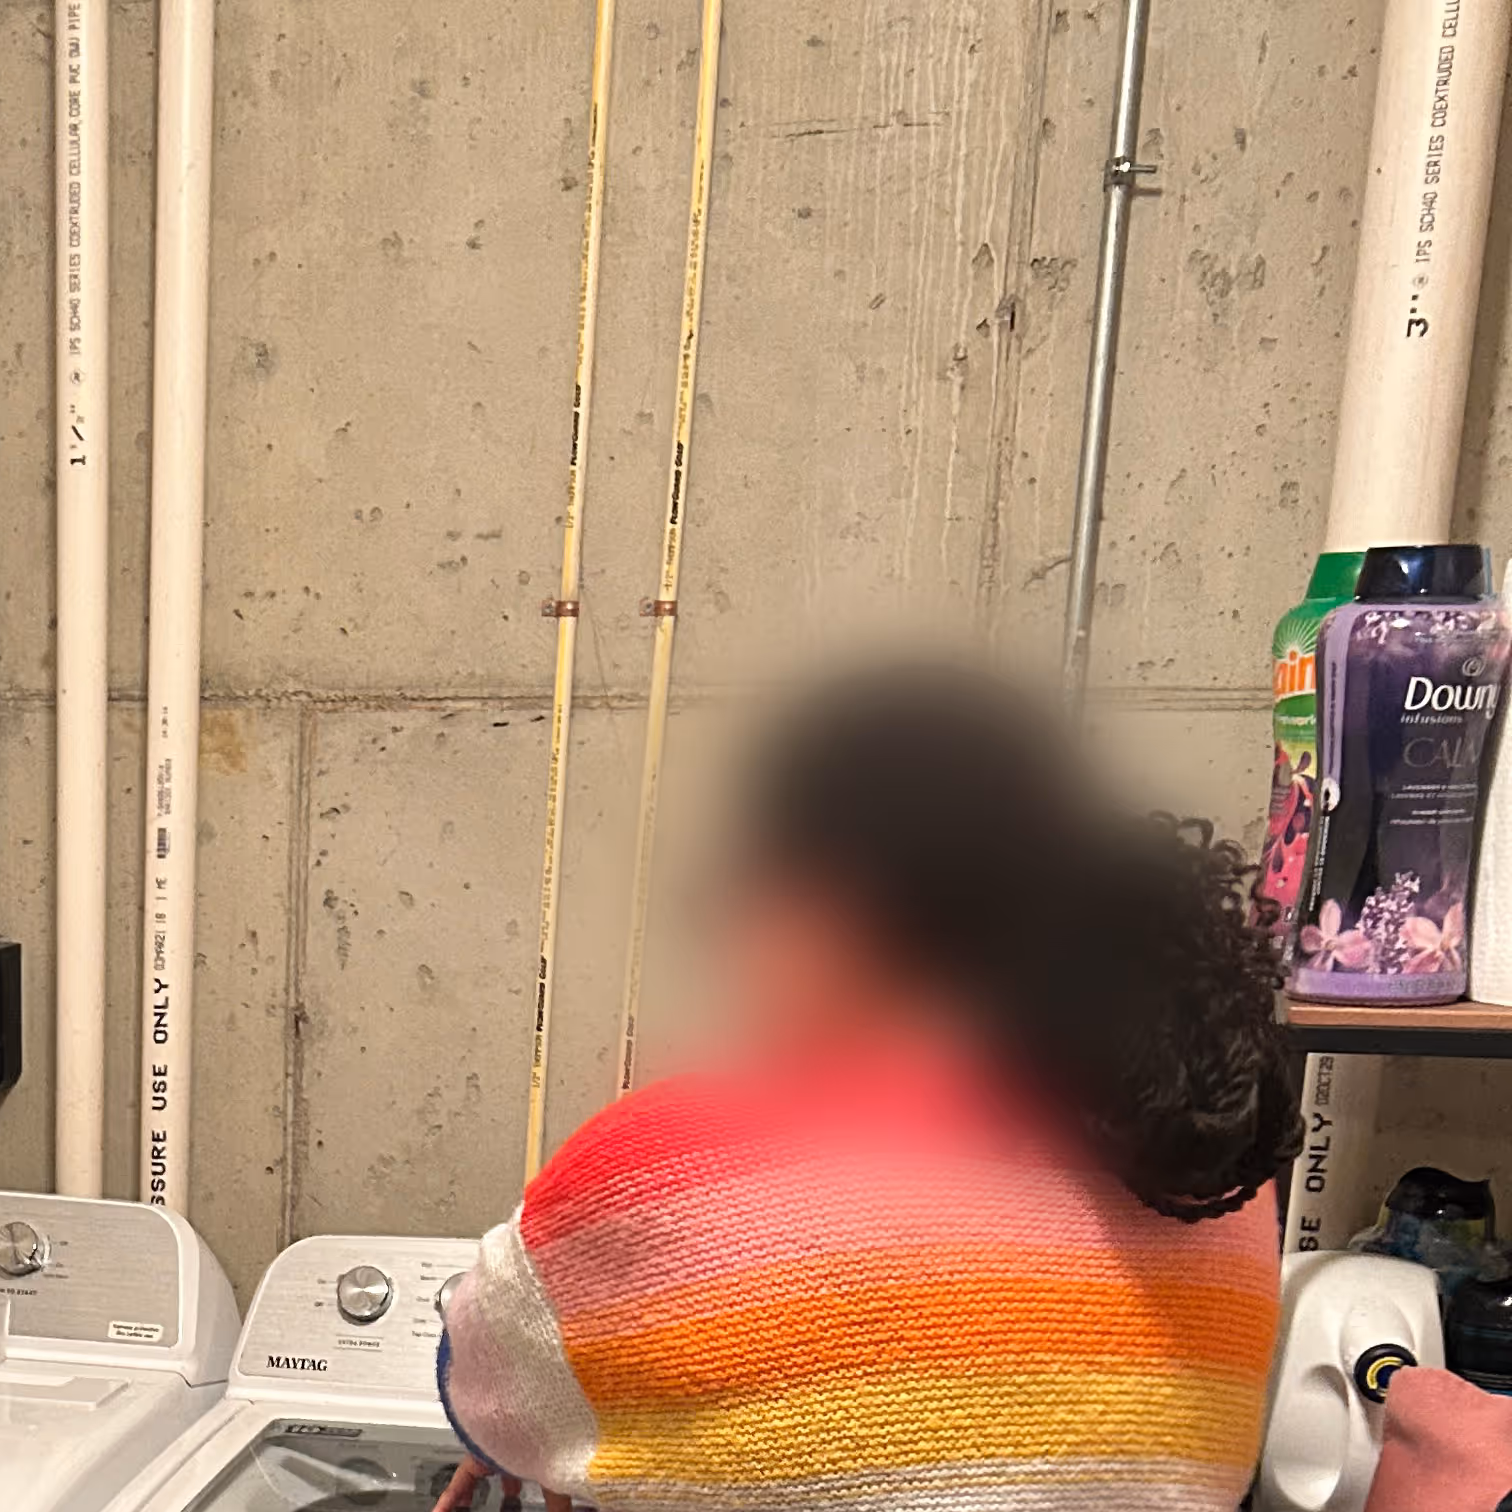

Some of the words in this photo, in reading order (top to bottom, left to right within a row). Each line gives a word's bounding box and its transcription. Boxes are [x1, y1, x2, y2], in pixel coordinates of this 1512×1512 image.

[68, 3, 81, 31] PIPE
[69, 63, 81, 85] PVC
[1431, 45, 1454, 128] COEXTRUDED
[69, 90, 81, 118] CORE
[69, 123, 81, 177] CELLULAR
[1425, 135, 1444, 185] SERIES
[69, 181, 81, 248] COEXTRUDED
[1419, 192, 1437, 233] SCH40
[1415, 240, 1432, 264] IPS
[69, 254, 81, 294] SERIES
[69, 337, 81, 355] IPS
[1400, 713, 1464, 725] infusions
[152, 977, 169, 1045] ONLY
[151, 1064, 168, 1111] USE
[1304, 1112, 1332, 1193] ONLY
[266, 1355, 328, 1372] MAYTAG
